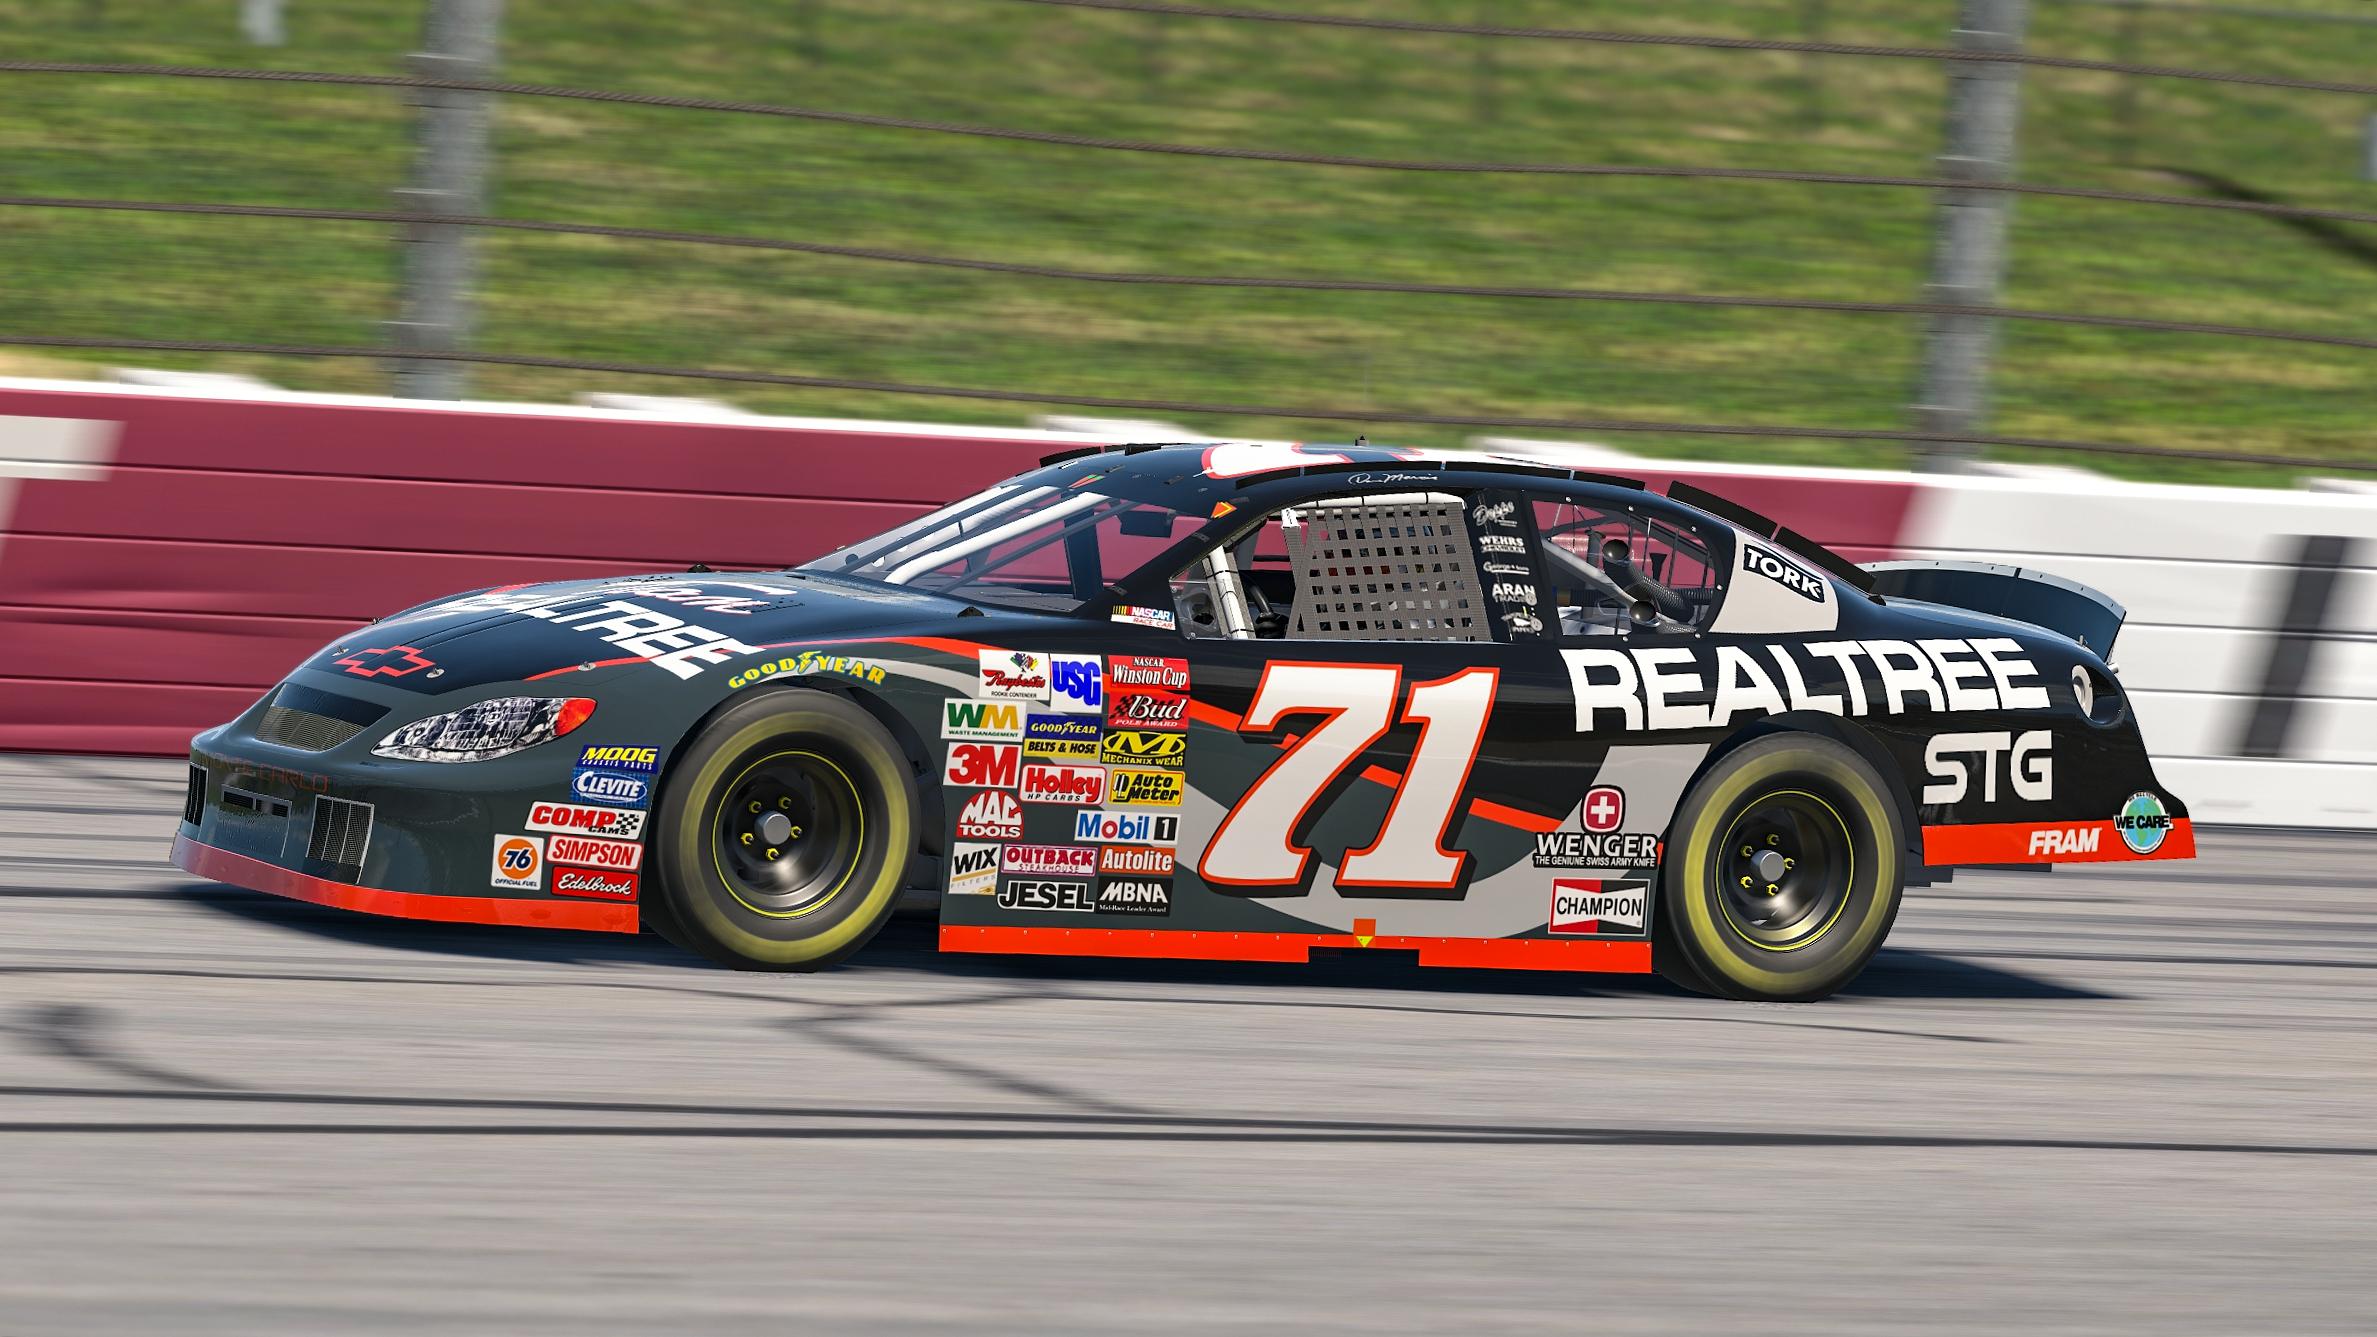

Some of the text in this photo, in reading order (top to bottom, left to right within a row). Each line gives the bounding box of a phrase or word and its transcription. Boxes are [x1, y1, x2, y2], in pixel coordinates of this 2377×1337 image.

[1479, 536, 1525, 547] WEHRS
[1747, 547, 1821, 599] TORK
[1131, 606, 1171, 622] NASCAR
[1133, 616, 1174, 629] RACE CAR
[728, 650, 887, 689] GOODYEAR
[1133, 656, 1165, 668] NASCAR
[1051, 660, 1101, 706] USG
[1112, 664, 1188, 689] Winston Cup
[1560, 637, 2051, 732] REALTREE
[990, 690, 1008, 698] ROOKIE
[947, 702, 1019, 730] WM
[1127, 695, 1188, 719] Bud
[1030, 721, 1098, 735] GOODYEAR
[1115, 719, 1178, 728] POLE AWARD
[582, 747, 658, 764] MOOG
[1028, 741, 1097, 755] BELTS & HOSE
[949, 744, 1019, 787] 3M
[1102, 752, 1184, 767] MECHANIX WEAR
[1923, 729, 2052, 804] STG
[577, 770, 645, 798] CLEVITE
[1025, 767, 1102, 804] Holley
[1131, 774, 1174, 788] Auto
[1198, 660, 1501, 896] 71
[1027, 793, 1081, 802] HP CARBS
[1128, 786, 1180, 801] Meter
[531, 805, 617, 828] COMP
[960, 791, 1022, 826] MAC
[588, 825, 630, 836] CAMS
[960, 825, 1021, 838] TOOLS
[1077, 813, 1170, 840] Mobil 1
[2114, 815, 2170, 830] WE CARE
[552, 838, 636, 866] SIMPSON
[1536, 833, 1657, 858] WENGER
[2028, 828, 2100, 856] FRAM
[503, 848, 532, 870] 76
[953, 847, 998, 875] WIX
[1006, 847, 1094, 866] OUTBACK
[1101, 848, 1173, 872] Autolite
[1535, 855, 1550, 865] THE
[1585, 856, 1610, 866] SWISS
[1610, 857, 1633, 867] ARMY
[1633, 858, 1656, 868] KNIFE
[1019, 864, 1080, 874] STEAKHOUSE
[494, 877, 537, 887] OFFICIAL FUEL
[557, 872, 633, 895] Edelbrock
[1100, 882, 1169, 903] MBNA
[999, 881, 1094, 910] JESEL
[1556, 896, 1643, 916] CHAMPION
